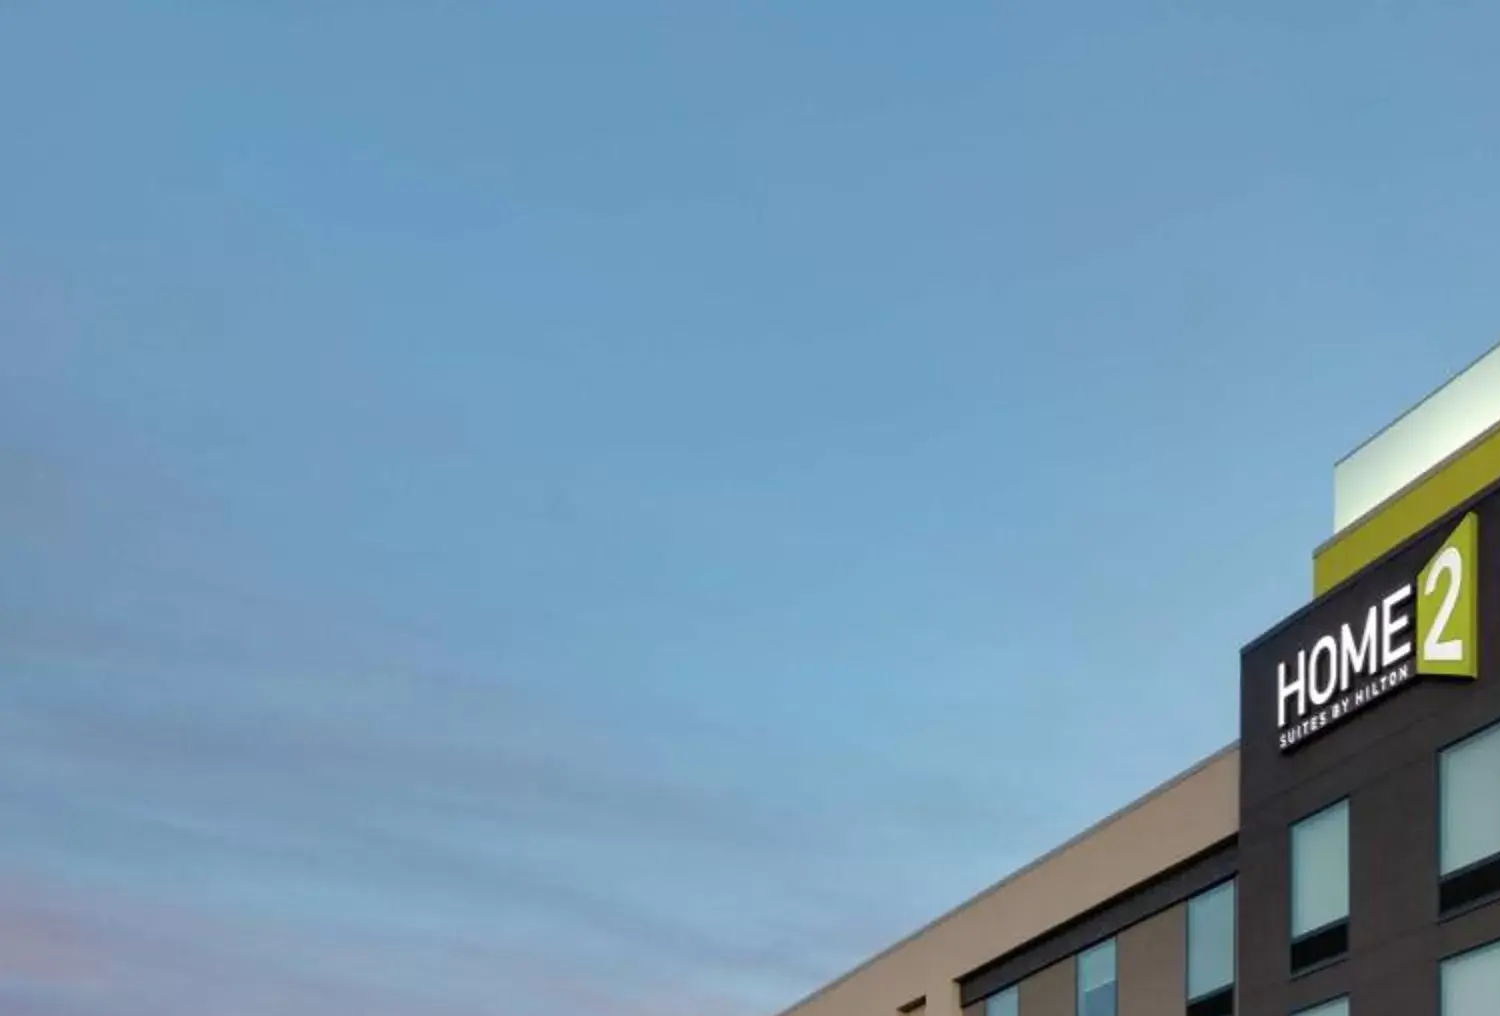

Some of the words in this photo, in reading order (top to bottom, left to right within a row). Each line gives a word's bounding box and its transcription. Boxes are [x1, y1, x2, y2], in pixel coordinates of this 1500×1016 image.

[1277, 583, 1412, 728] HOME
[1423, 547, 1463, 661] 2
[1279, 712, 1327, 749] SUITES
[1332, 697, 1351, 719] BY
[1354, 666, 1410, 705] HILTON
